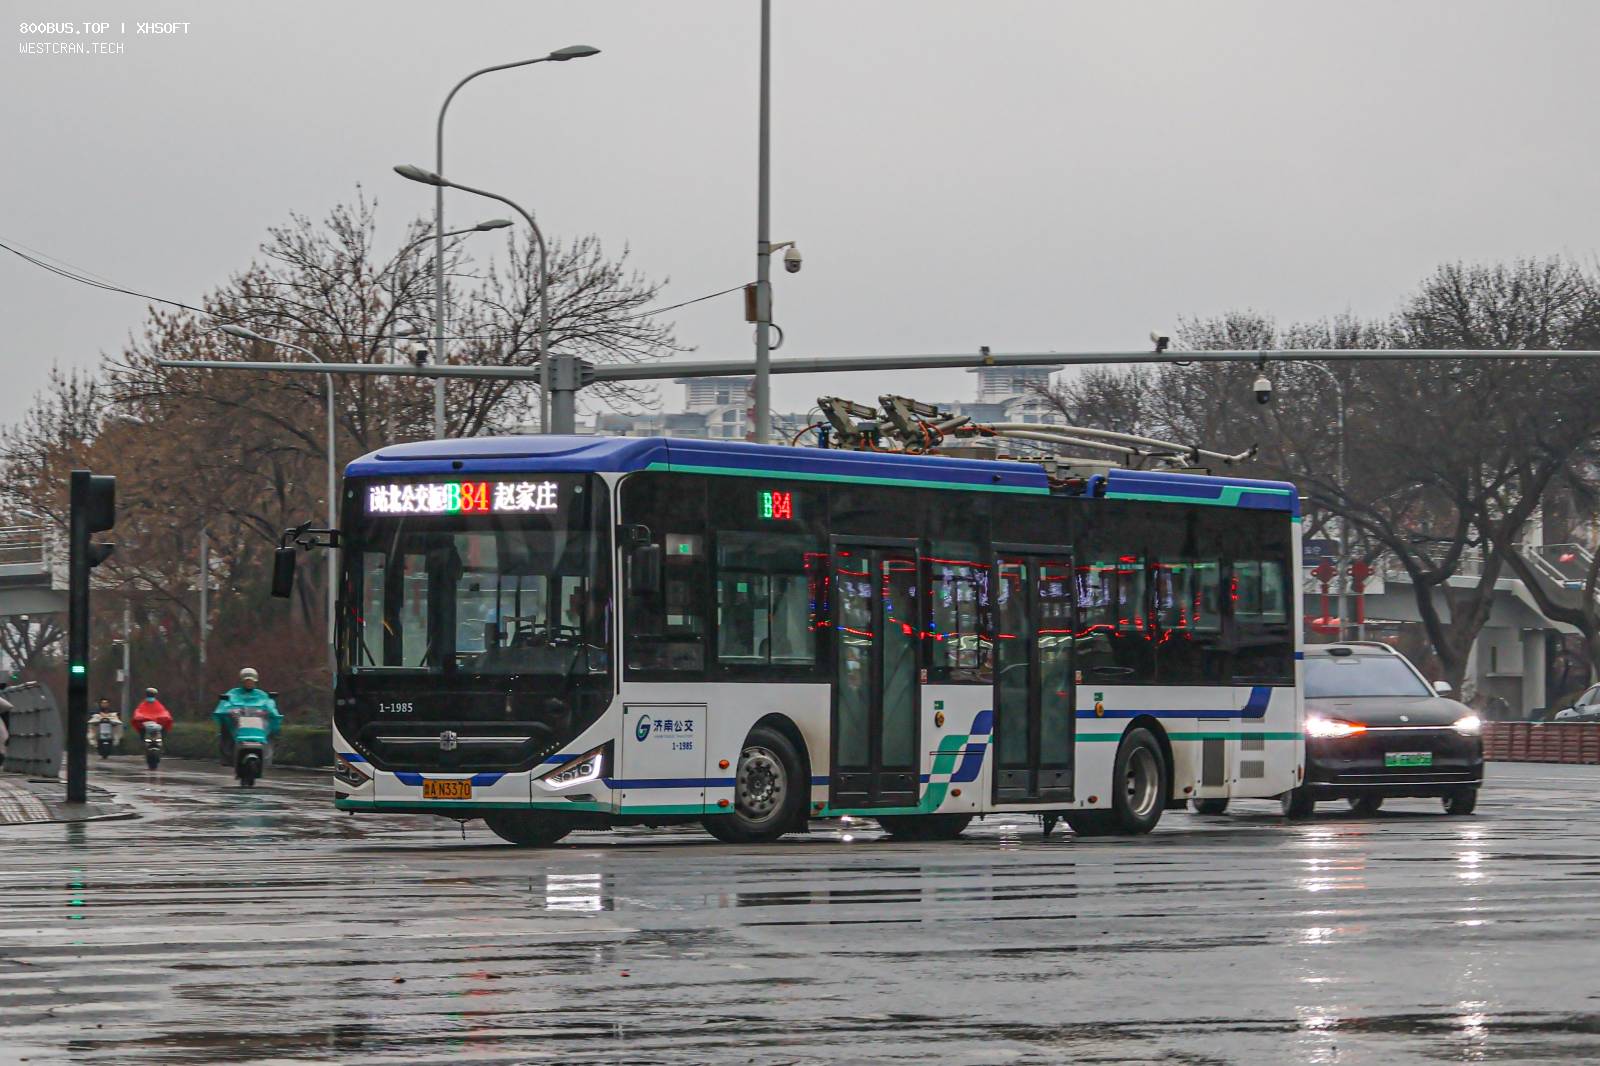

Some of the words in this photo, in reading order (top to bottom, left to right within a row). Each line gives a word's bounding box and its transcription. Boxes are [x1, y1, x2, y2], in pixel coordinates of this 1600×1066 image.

[447, 482, 489, 511] B84
[494, 481, 558, 511] 赵家庄
[763, 491, 791, 519] B84
[379, 702, 413, 713] 1-1985
[653, 719, 694, 732] 济南公交
[672, 741, 693, 751] 1-1985
